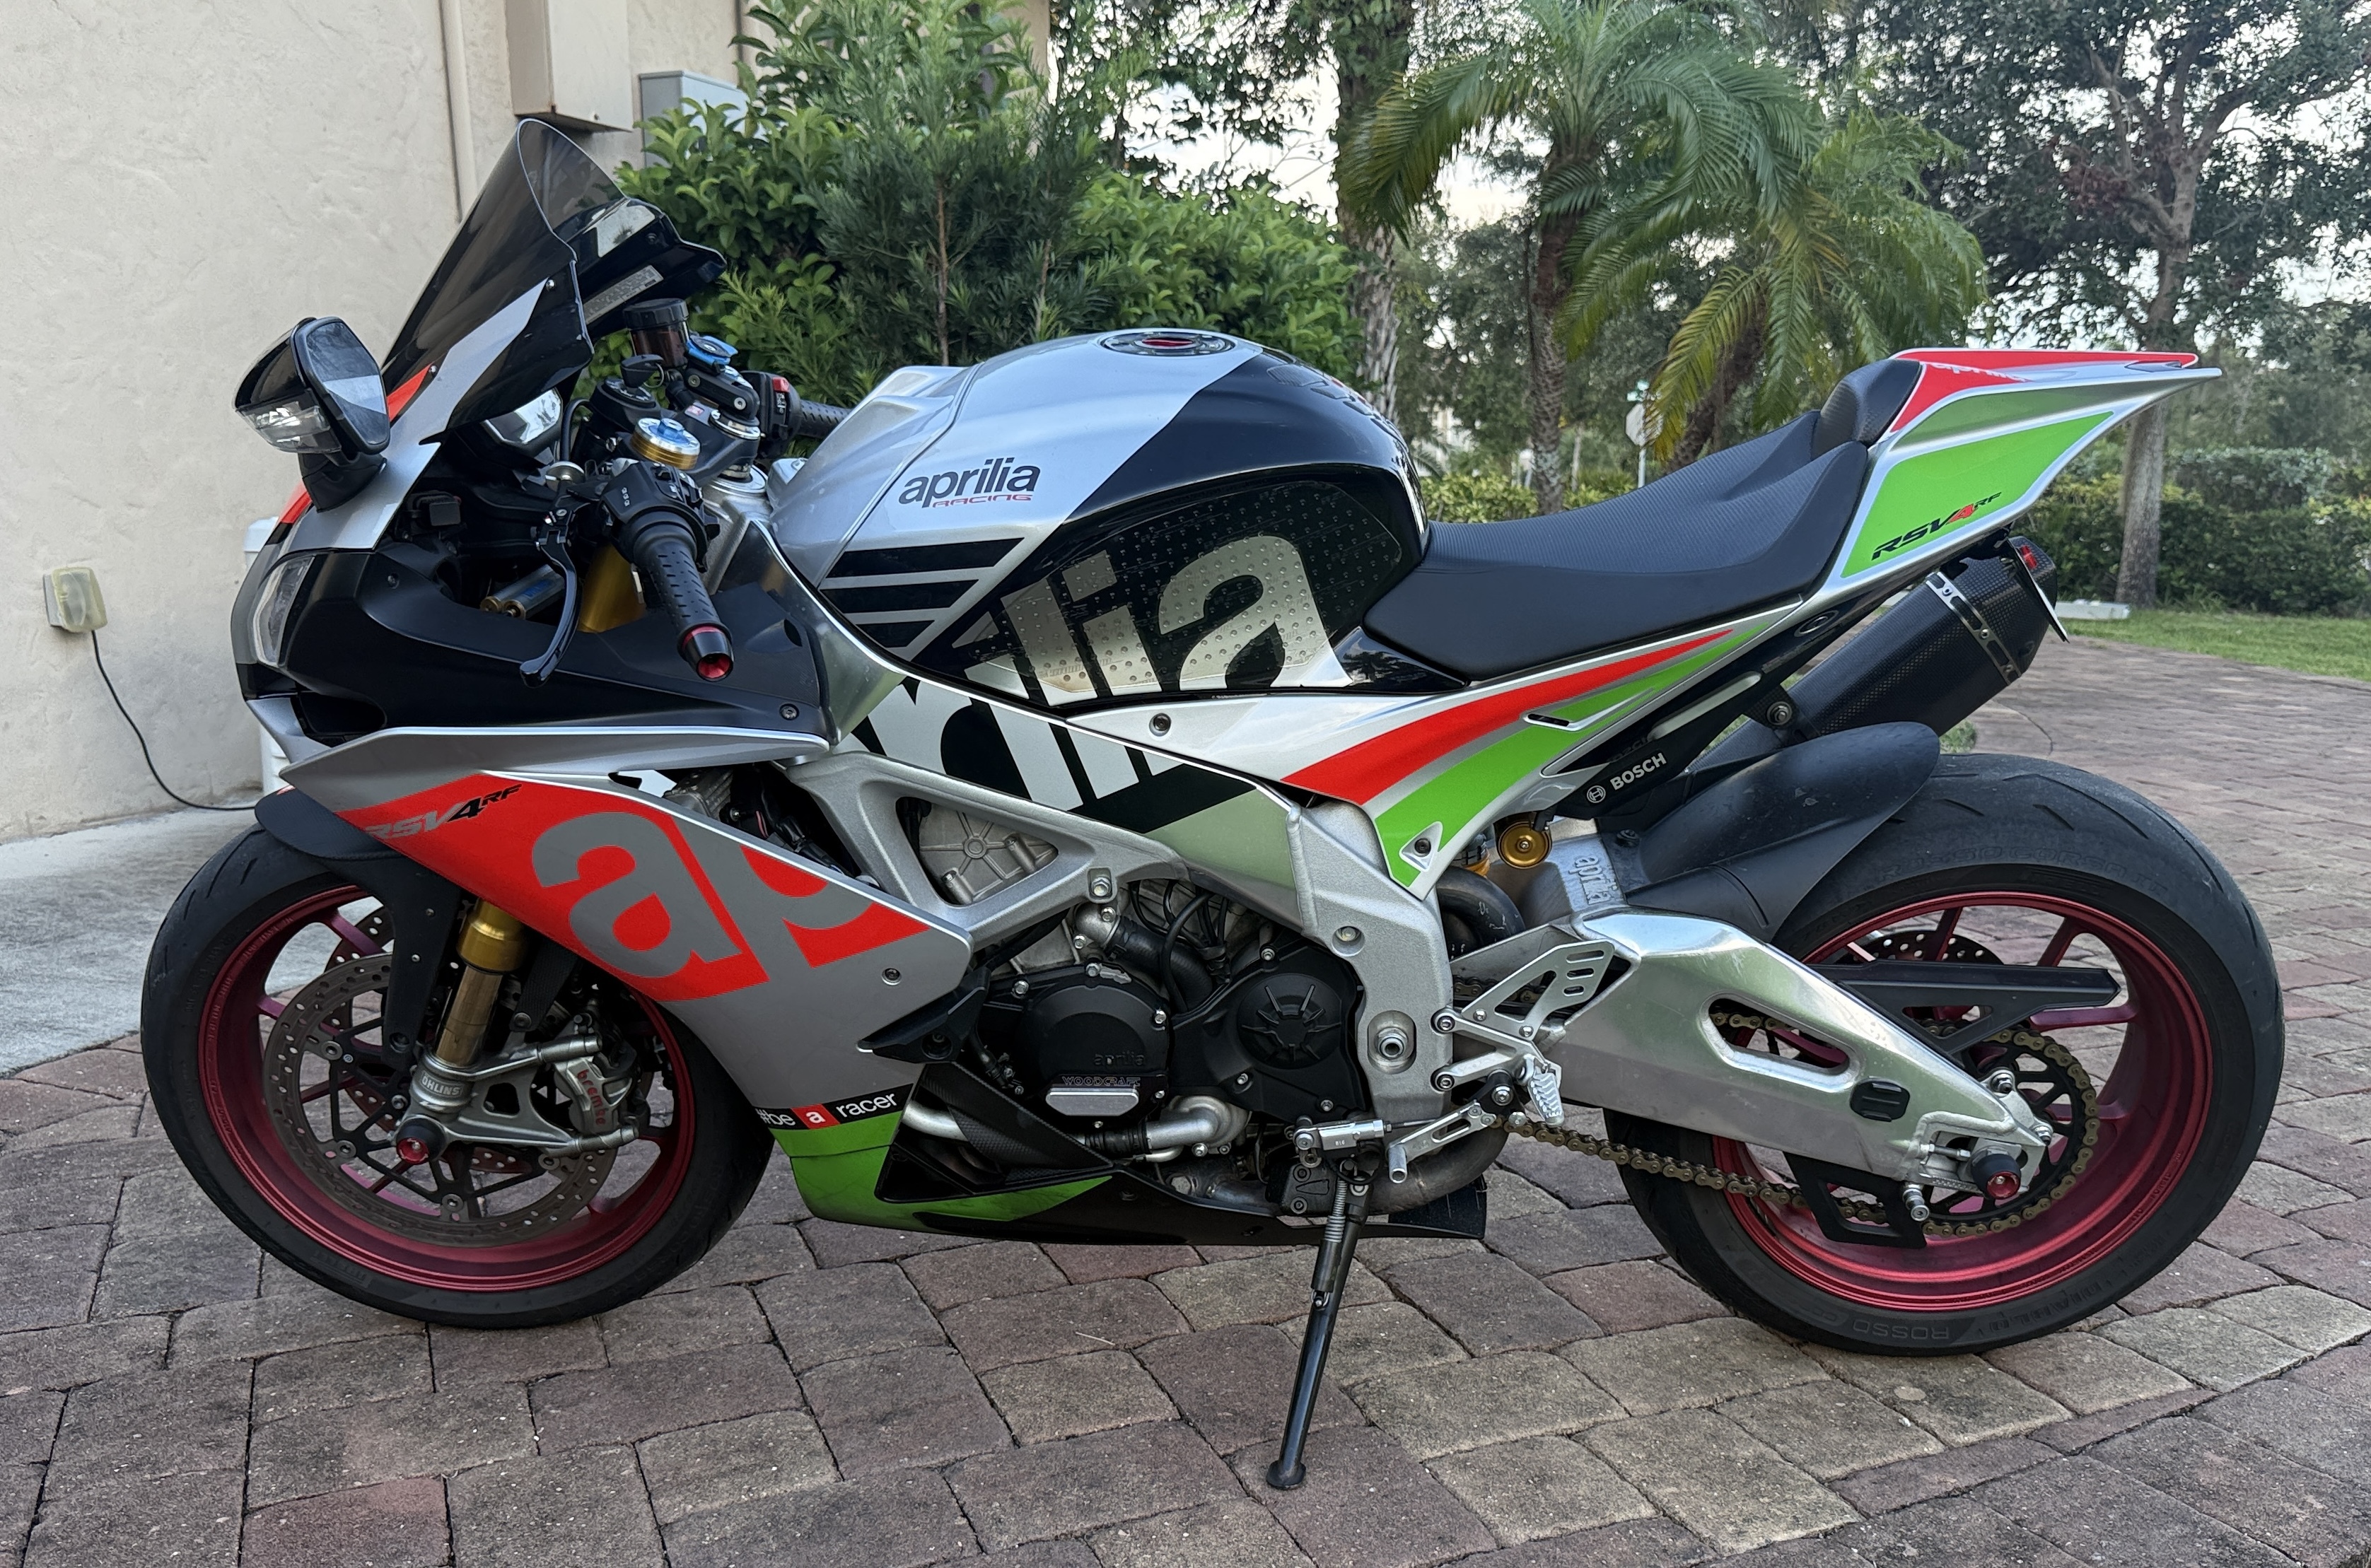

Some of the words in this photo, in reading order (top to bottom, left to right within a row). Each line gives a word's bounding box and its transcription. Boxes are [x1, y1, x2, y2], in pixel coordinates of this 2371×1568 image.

[898, 457, 1041, 509] aprilia
[932, 493, 1033, 508] RACING
[1609, 752, 1667, 790] BOSCH
[1061, 1076, 1141, 1087] WOODCRAFT
[755, 1108, 796, 1126] #be
[805, 1111, 826, 1124] a
[836, 1092, 897, 1118] racer
[1852, 1321, 1950, 1340] ROSSO
